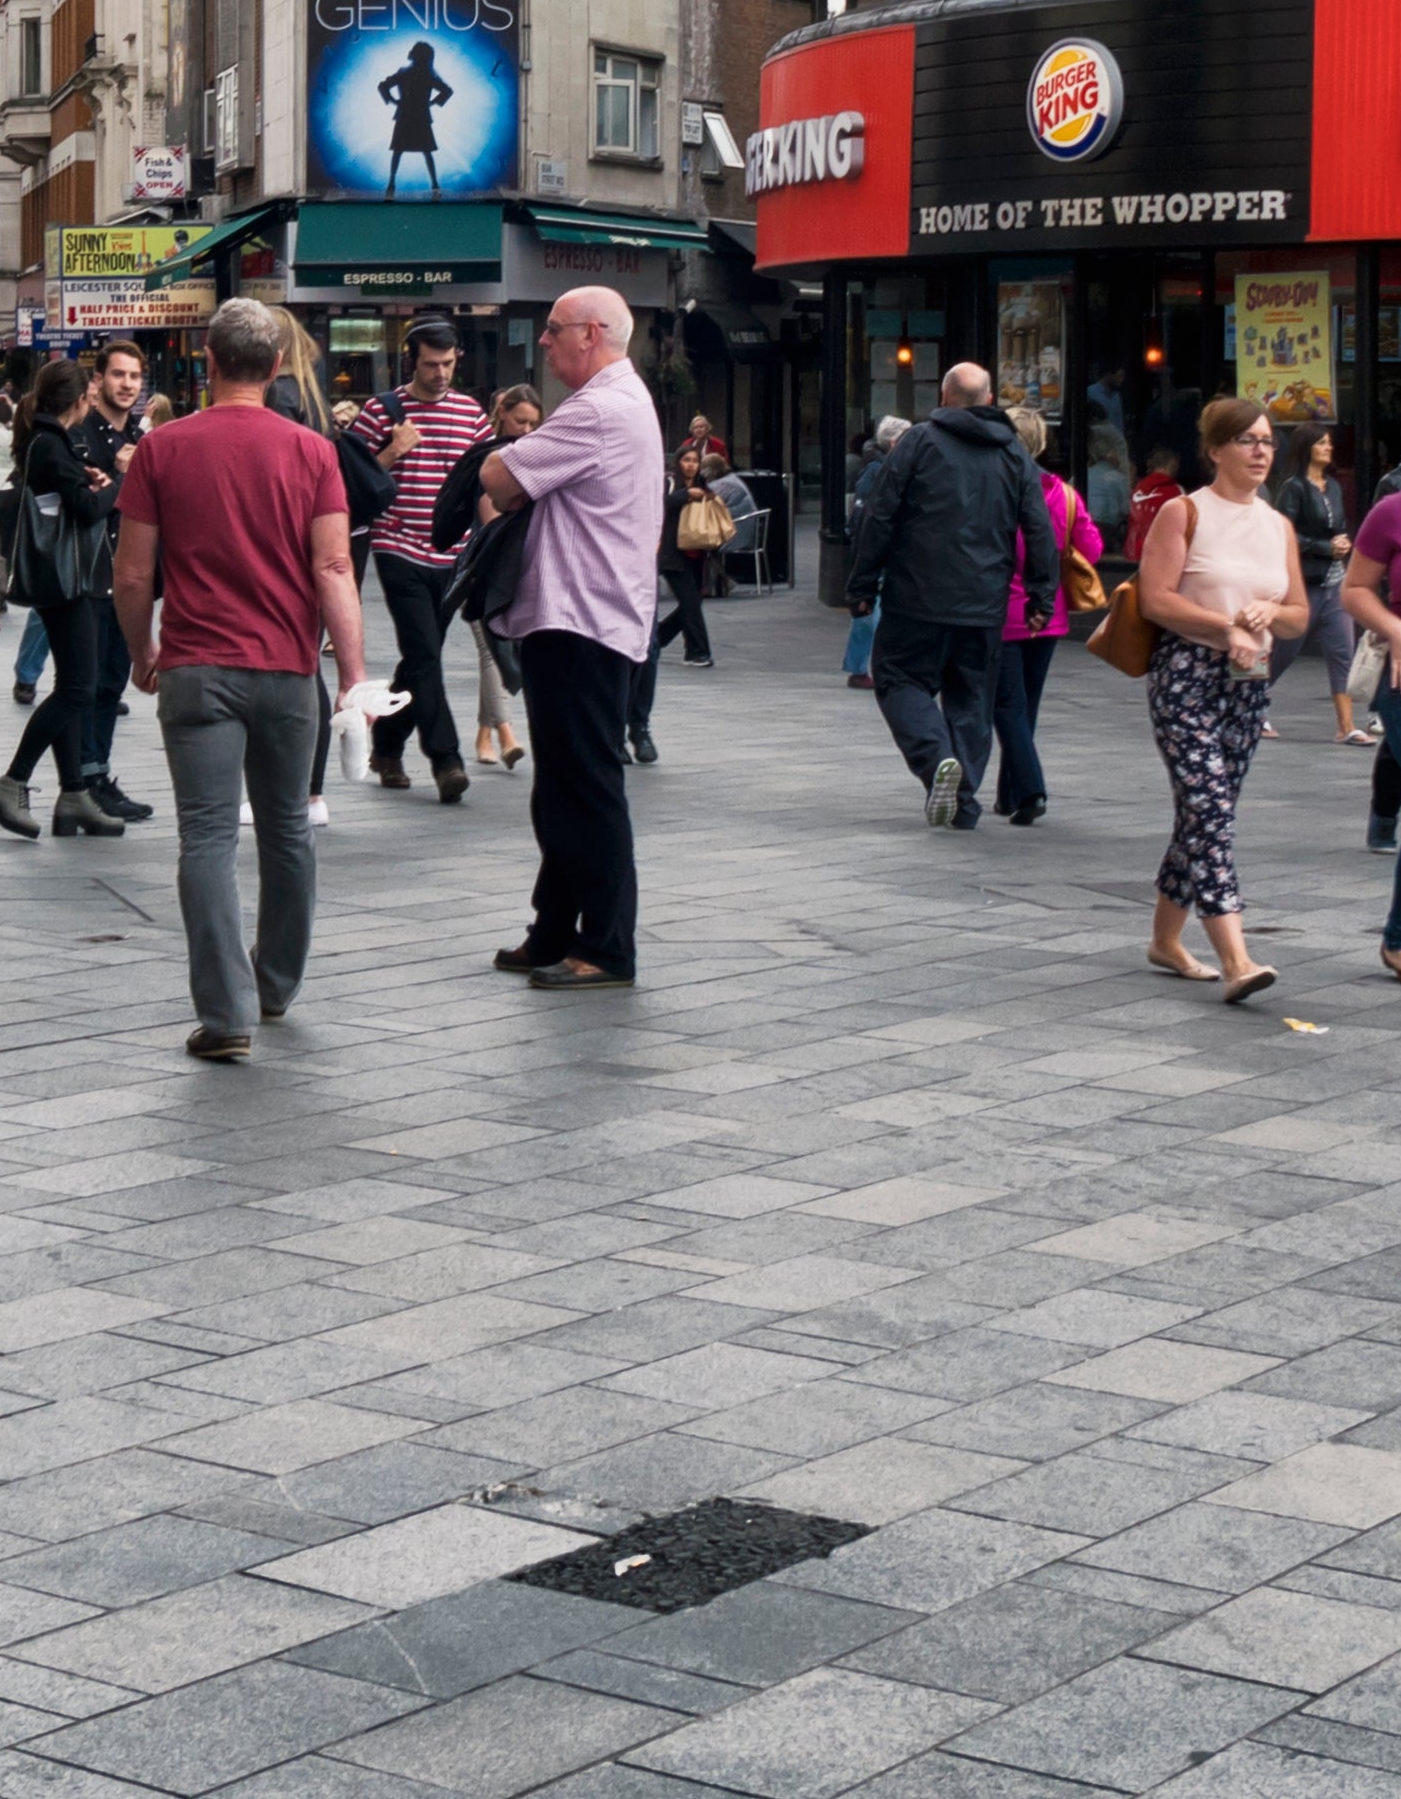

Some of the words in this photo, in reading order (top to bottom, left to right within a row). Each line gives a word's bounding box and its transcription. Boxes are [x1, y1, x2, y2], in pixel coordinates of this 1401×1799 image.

[1036, 61, 1097, 107] BURGER
[1038, 80, 1099, 137] KING
[777, 110, 865, 187] KING
[145, 157, 164, 167] Fish
[165, 157, 173, 167] &
[146, 168, 173, 180] Chips
[146, 181, 173, 189] OPEN
[918, 203, 989, 235] HOME
[997, 200, 1033, 231] OF
[1041, 198, 1103, 228] THE
[1111, 190, 1287, 225] WHOPPER
[65, 231, 108, 253] SUNNY
[64, 252, 138, 273] AFTERNOON
[544, 246, 604, 272] ESPRESSO
[615, 251, 640, 274] BAR
[343, 272, 414, 285] ESPRESSO
[423, 271, 453, 283] BAR
[64, 282, 121, 293] LEICESTER
[187, 282, 215, 291] OFFICE
[110, 294, 128, 303] THE
[129, 293, 170, 303] OFFICIAL
[79, 305, 103, 314] HALF
[105, 304, 135, 314] PRICE
[148, 303, 199, 313] DISCOUNT
[82, 316, 124, 326] THEATRE
[127, 315, 161, 326] TICKET
[164, 315, 200, 326] BOOTH
